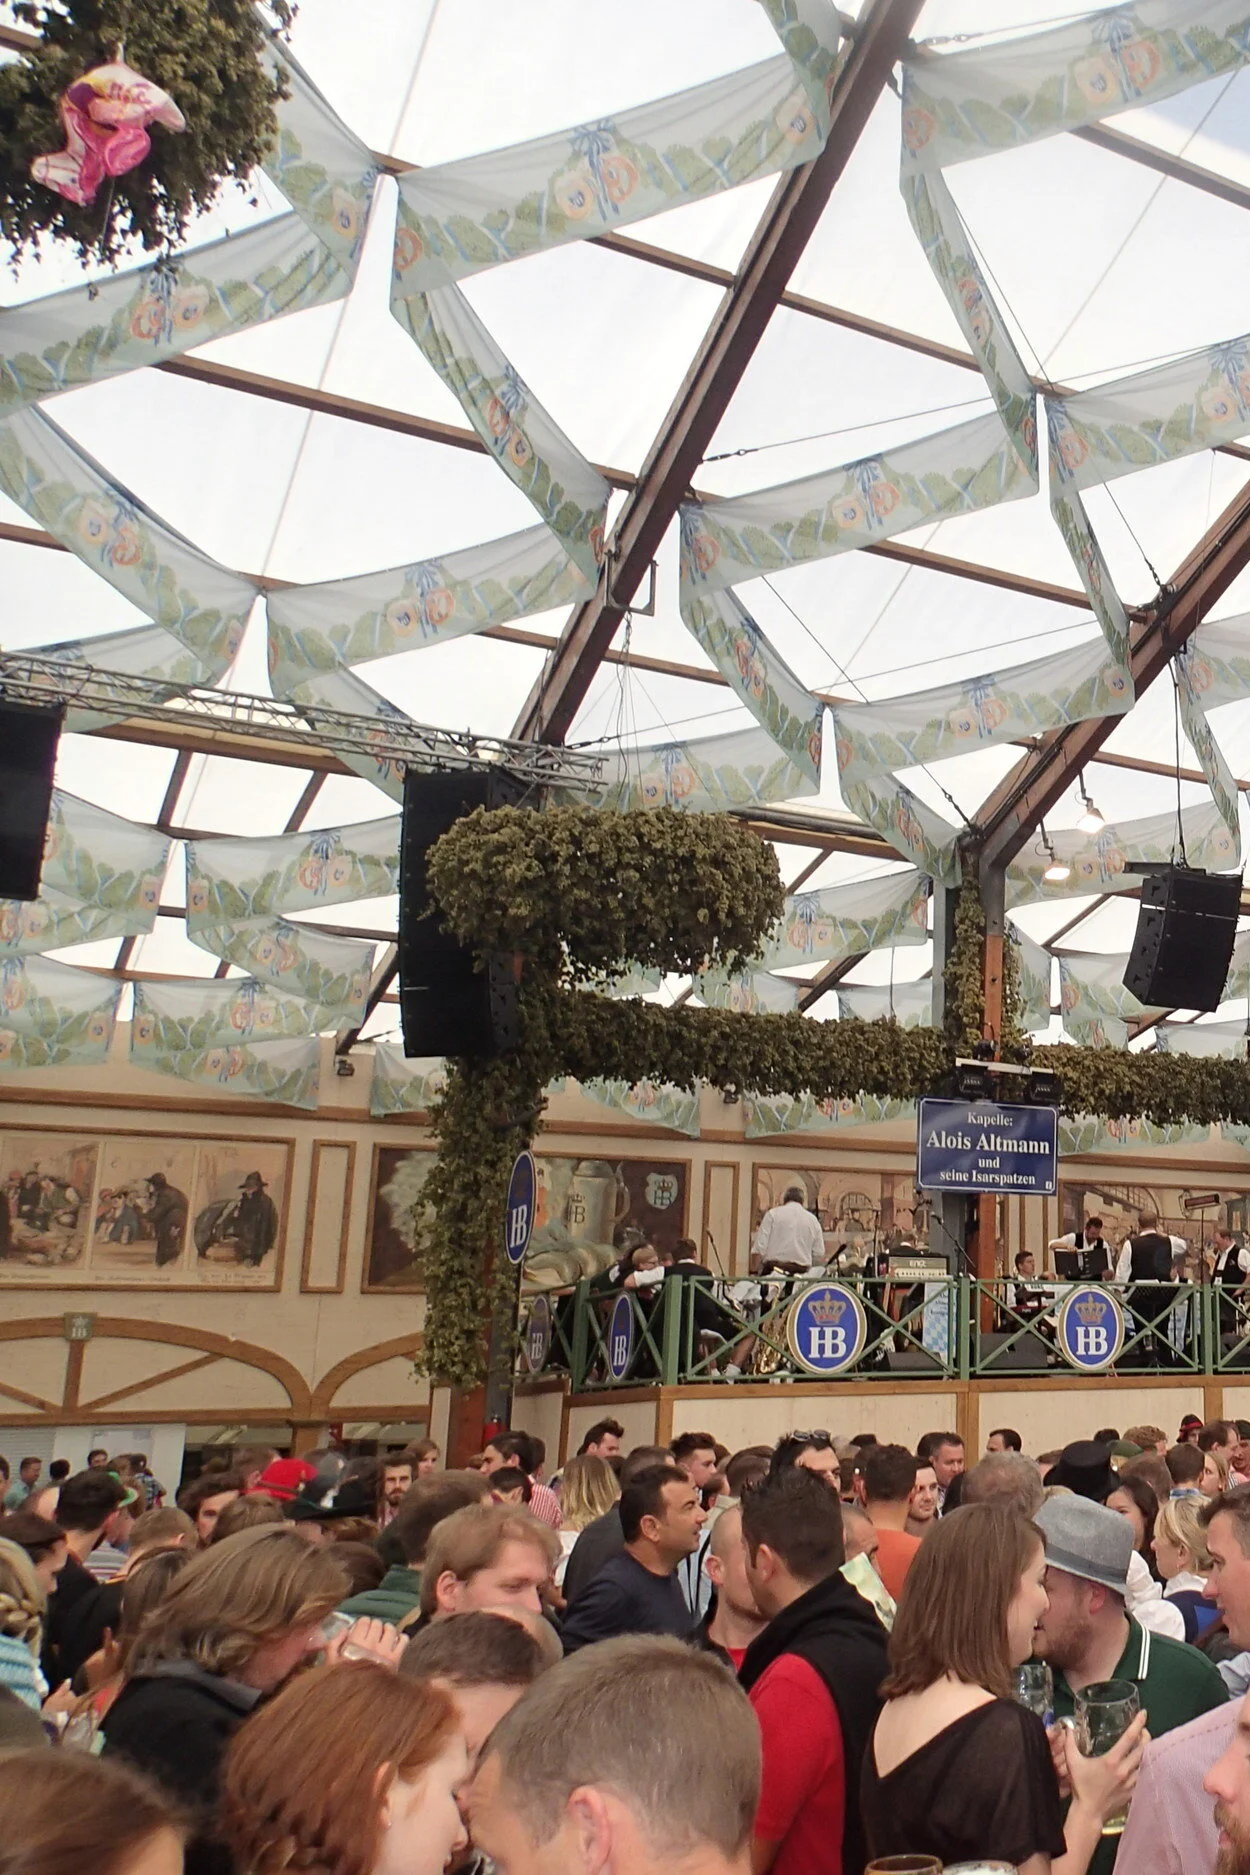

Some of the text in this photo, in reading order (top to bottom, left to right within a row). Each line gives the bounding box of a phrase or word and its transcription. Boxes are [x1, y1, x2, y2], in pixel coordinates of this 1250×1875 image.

[967, 1111, 1013, 1128] Kapelle:
[926, 1129, 1050, 1155] Alois Altmann
[978, 1156, 1000, 1169] und
[940, 1168, 1036, 1186] seine Isarspatzen
[510, 1204, 528, 1248] HB
[613, 1335, 628, 1367] HB
[808, 1326, 847, 1359] HB
[1076, 1326, 1109, 1356] HB
